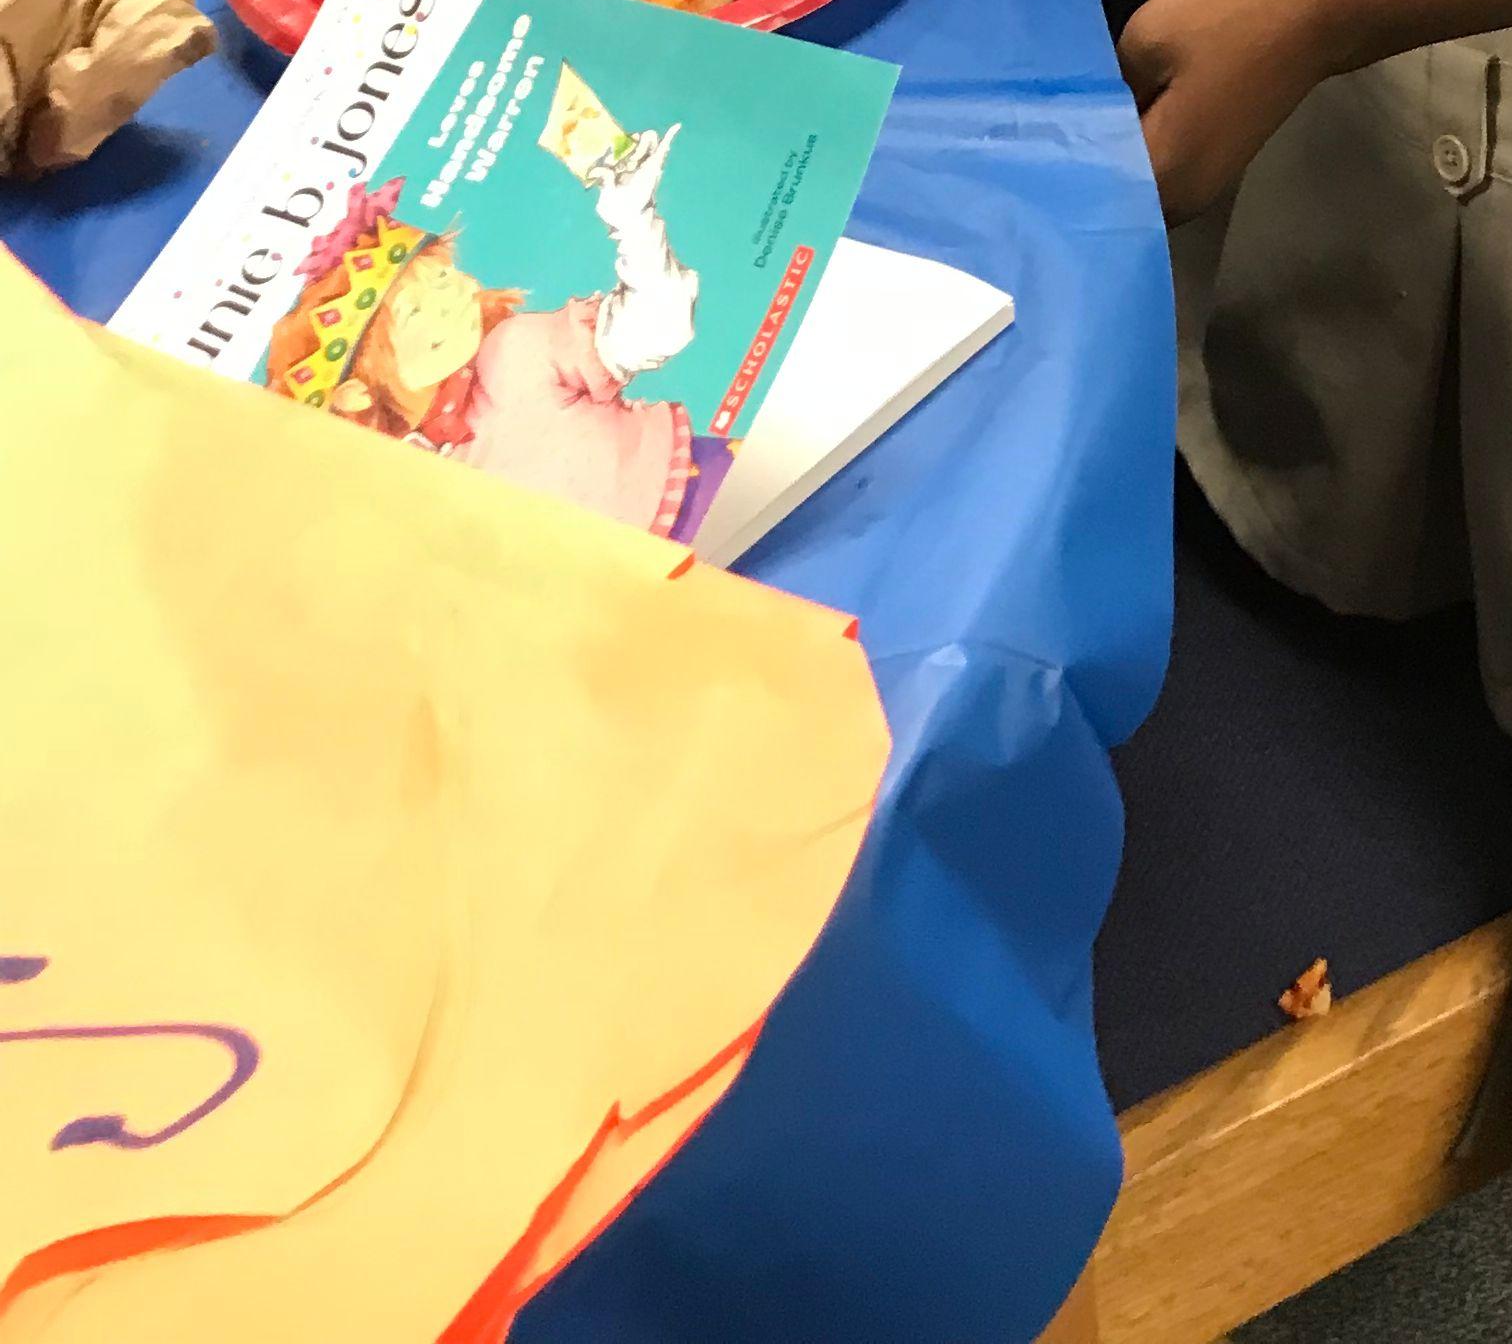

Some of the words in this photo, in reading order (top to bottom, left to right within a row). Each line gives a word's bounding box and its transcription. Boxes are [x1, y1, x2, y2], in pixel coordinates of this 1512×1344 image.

[419, 13, 533, 208] Handsome
[427, 59, 486, 149] Loves
[463, 54, 546, 183] Warren
[753, 209, 788, 268] Denise
[726, 249, 809, 408] SCHOLASTIC
